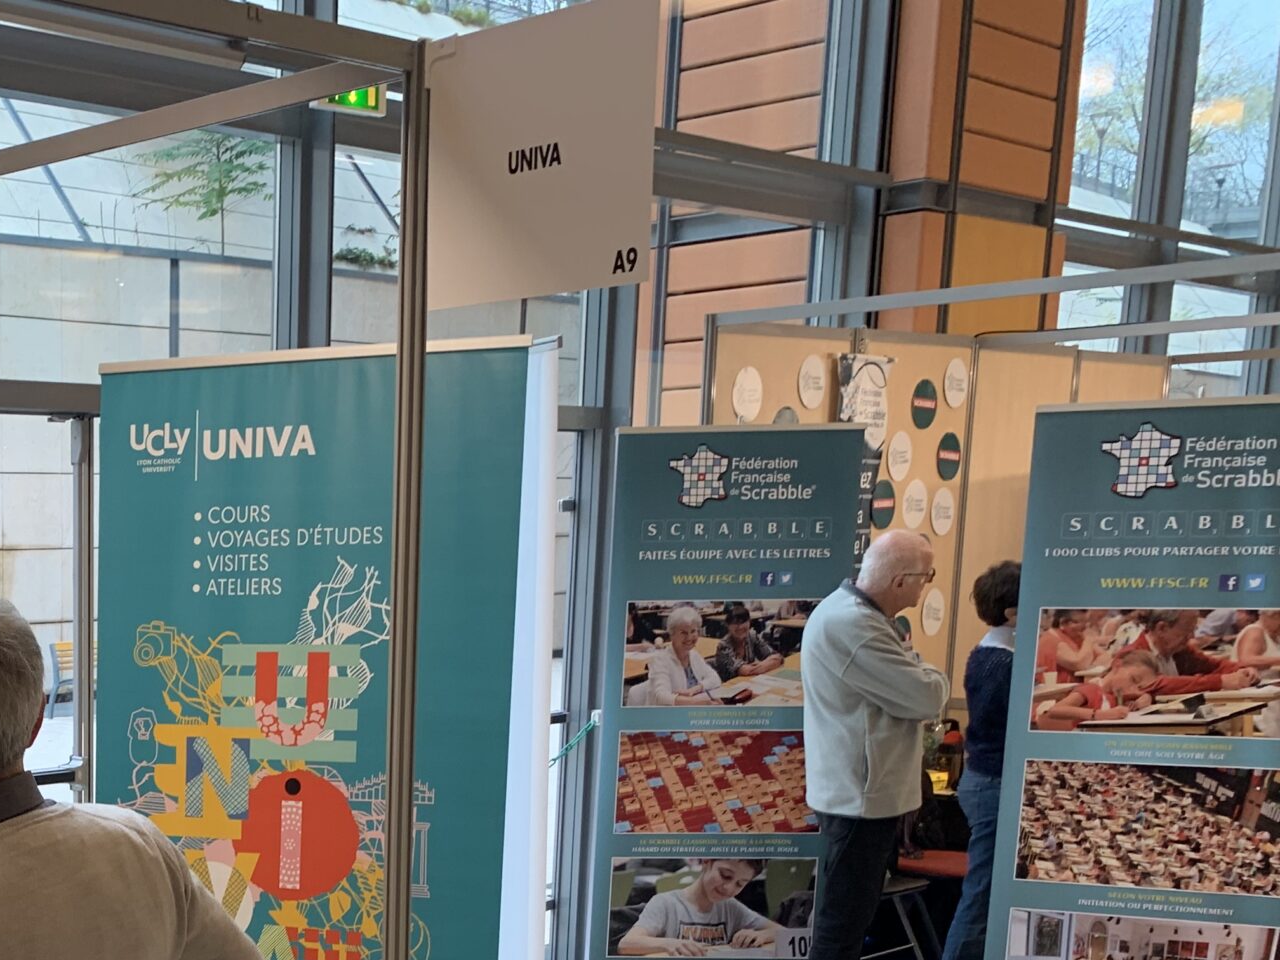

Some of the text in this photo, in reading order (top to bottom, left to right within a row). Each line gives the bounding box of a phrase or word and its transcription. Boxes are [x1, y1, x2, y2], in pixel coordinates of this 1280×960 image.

[508, 142, 562, 175] UNIVA
[612, 247, 638, 275] A9
[202, 425, 316, 461] UNIVA
[1185, 436, 1278, 452] Fédération
[731, 457, 799, 470] Fédération
[1183, 454, 1268, 472] Française
[730, 471, 791, 485] Française
[1181, 470, 1280, 489] de Scrabbl
[729, 487, 740, 496] de
[207, 504, 271, 526] COURS
[1069, 514, 1276, 532] SCRABBL
[207, 524, 384, 549] VOYAGES D'ÉTUDES
[638, 548, 832, 561] FAITES ÉQUIPE AVEC LES LETTRES
[1081, 547, 1121, 558] CLUBS
[1124, 547, 1160, 557] POUR
[1162, 546, 1231, 557] PARTAGER
[1232, 546, 1276, 556] VOTRE
[207, 553, 270, 573] VISITES
[206, 577, 283, 597] ATELIERS
[672, 574, 753, 585] WWW.FFSC.FR
[1100, 577, 1210, 589] WWW.FFSC.FR
[1078, 899, 1235, 916] INITIATION OU PERFECTIONNEMENT
[1137, 893, 1166, 902] VOTRE
[1168, 895, 1203, 905] NIVEAU
[788, 936, 812, 958] 10
